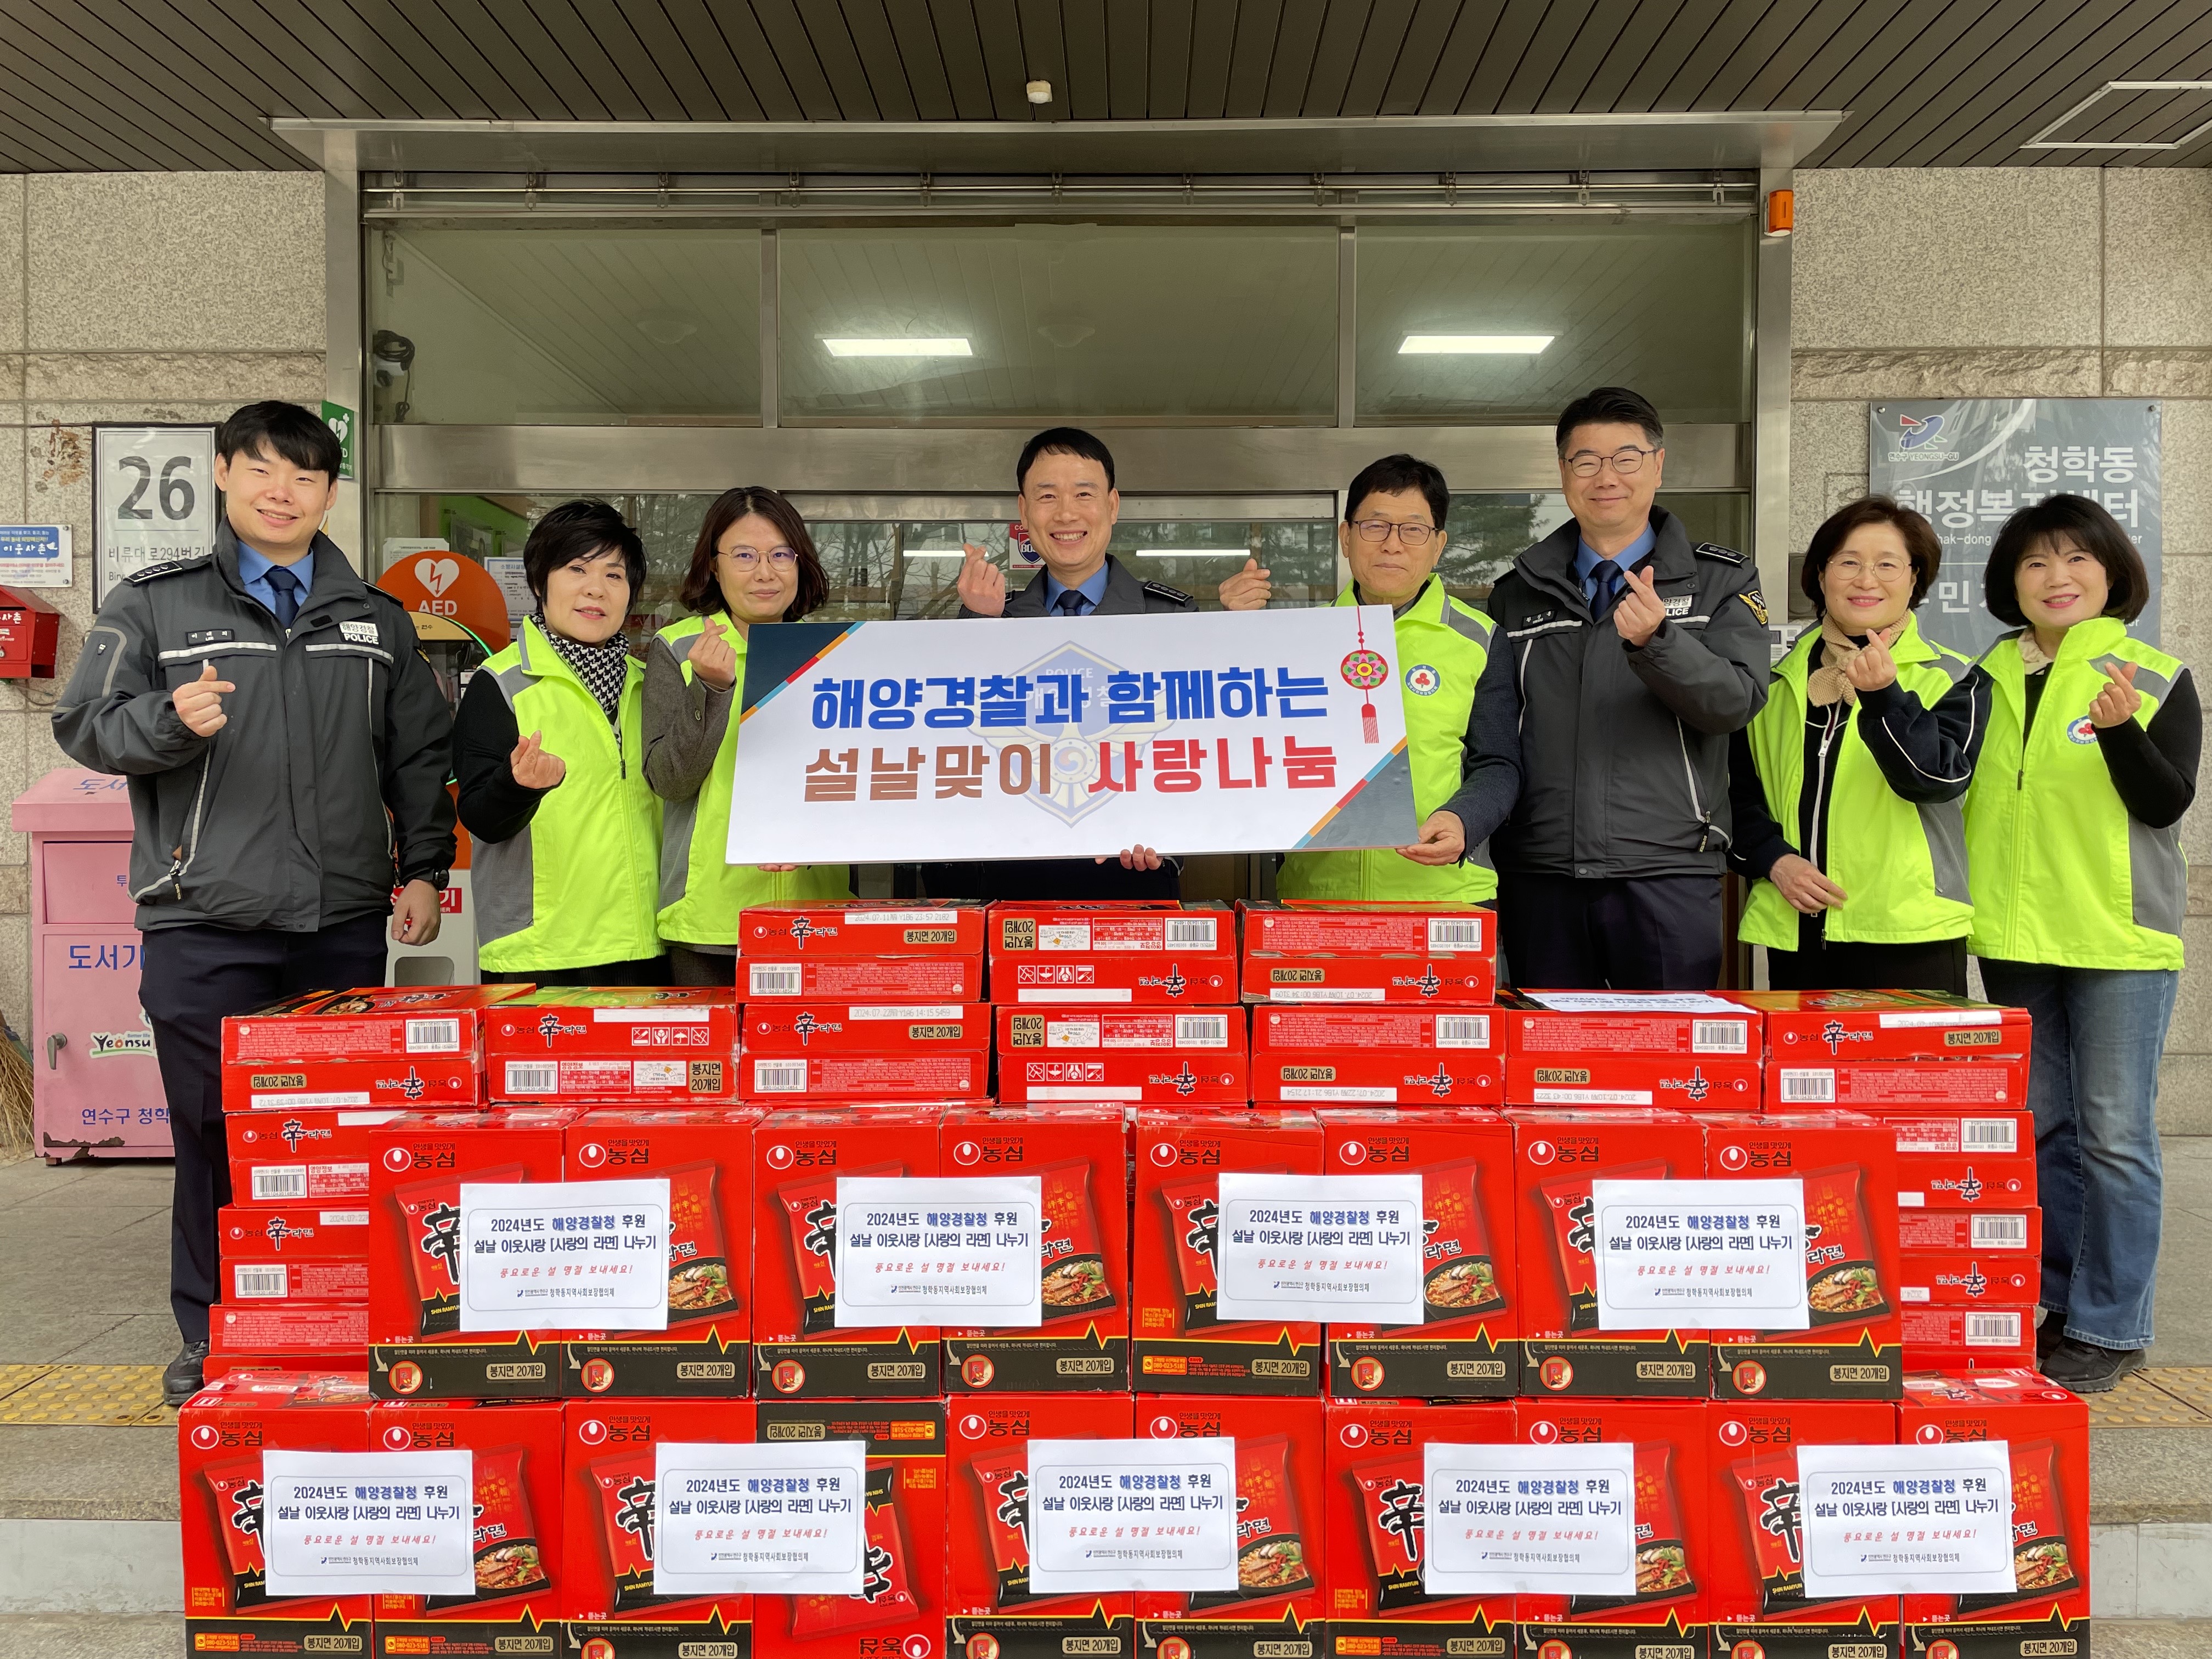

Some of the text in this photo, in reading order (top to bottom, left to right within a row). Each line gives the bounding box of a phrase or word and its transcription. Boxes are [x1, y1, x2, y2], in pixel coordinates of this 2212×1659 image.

[1888, 453, 1959, 461] 연수구 YEONGSU-GU
[2024, 446, 2138, 484] 청학동
[118, 456, 195, 520] 26
[419, 600, 457, 616] AED
[1662, 597, 1689, 606] 양경찰
[1666, 607, 1689, 616] LICE
[341, 623, 374, 634] 해양경찰
[343, 633, 379, 645] POLICE
[812, 674, 1089, 730] 해양경찰과
[1107, 667, 1329, 724] 함께하는
[804, 736, 1337, 802] 설날맞이 사랑나눔
[906, 930, 955, 942] 봉지면 20개입
[1273, 970, 1322, 980] 봉지면 20개입
[93, 1035, 150, 1052] Yeonsu
[1948, 1031, 1999, 1045] 봉지면 20개입
[692, 1063, 721, 1091] 봉지면 20개입
[82, 1109, 130, 1125] 연수구
[413, 1152, 456, 1169] 농심
[608, 1148, 649, 1165] 농심
[794, 1149, 837, 1166] 농심
[983, 1146, 1023, 1162] 농심
[1179, 1149, 1221, 1165] 농심
[1368, 1146, 1409, 1162] 농심
[1557, 1146, 1599, 1162] 농심
[1749, 1151, 1791, 1167] 농심
[492, 1215, 645, 1232] 2024년도 해양경찰청 후원
[867, 1212, 1017, 1227] 2024년도 해양경찰청 후원
[1250, 1210, 1398, 1225] 2024년도 해양경찰청 후원
[1626, 1215, 1780, 1229] 2024년도 해양경찰청 후원
[474, 1235, 656, 1253] 설날 이웃사랑 [사랑의 라면] 나누기
[850, 1233, 1028, 1248] 설날 이웃사랑 [사랑의 라면] 나누기
[1232, 1230, 1409, 1245] 설날 이웃사랑 [사랑의 라면] 나누기
[1610, 1235, 1792, 1250] 설날 이웃사랑 [사랑의 라면] 나누기
[1425, 1239, 1462, 1259] 라면
[876, 1263, 1005, 1273] 풍요로운 설 명절 보내세요!
[1638, 1265, 1769, 1276] 풍요로운 설 명절 보내세요!
[490, 1365, 544, 1378] 봉지면 20개입
[871, 1364, 922, 1378] 봉지면 20개입
[1255, 1361, 1308, 1376] 봉지면 20개입
[1834, 1367, 1887, 1380] 봉지면 20개입
[770, 1425, 821, 1438] 봉지면 20개입
[687, 1477, 839, 1493] 2024년도 해양경찰청 후원
[1059, 1474, 1211, 1490] 2024년도 해양경찰청 후원
[1457, 1480, 1609, 1495] 2024년도 해양경찰청 후원
[1832, 1478, 1986, 1494] 2024년도 해양경찰청 후원
[294, 1486, 447, 1499] 2024년도 해양경찰청 후원
[669, 1499, 850, 1514] 설날 이웃사랑 [사랑의 라면] 나누기
[1043, 1496, 1222, 1511] 설날 이웃사랑 [사랑의 라면] 나누기
[1438, 1500, 1621, 1515] 설날 이웃사랑 [사랑의 라면] 나누기
[1815, 1499, 1998, 1517] 설날 이웃사랑 [사랑의 라면] 나누기
[278, 1506, 459, 1520] 설날 이웃사랑 [사랑의 라면] 나누기
[307, 1636, 359, 1650] 봉지면 20개입
